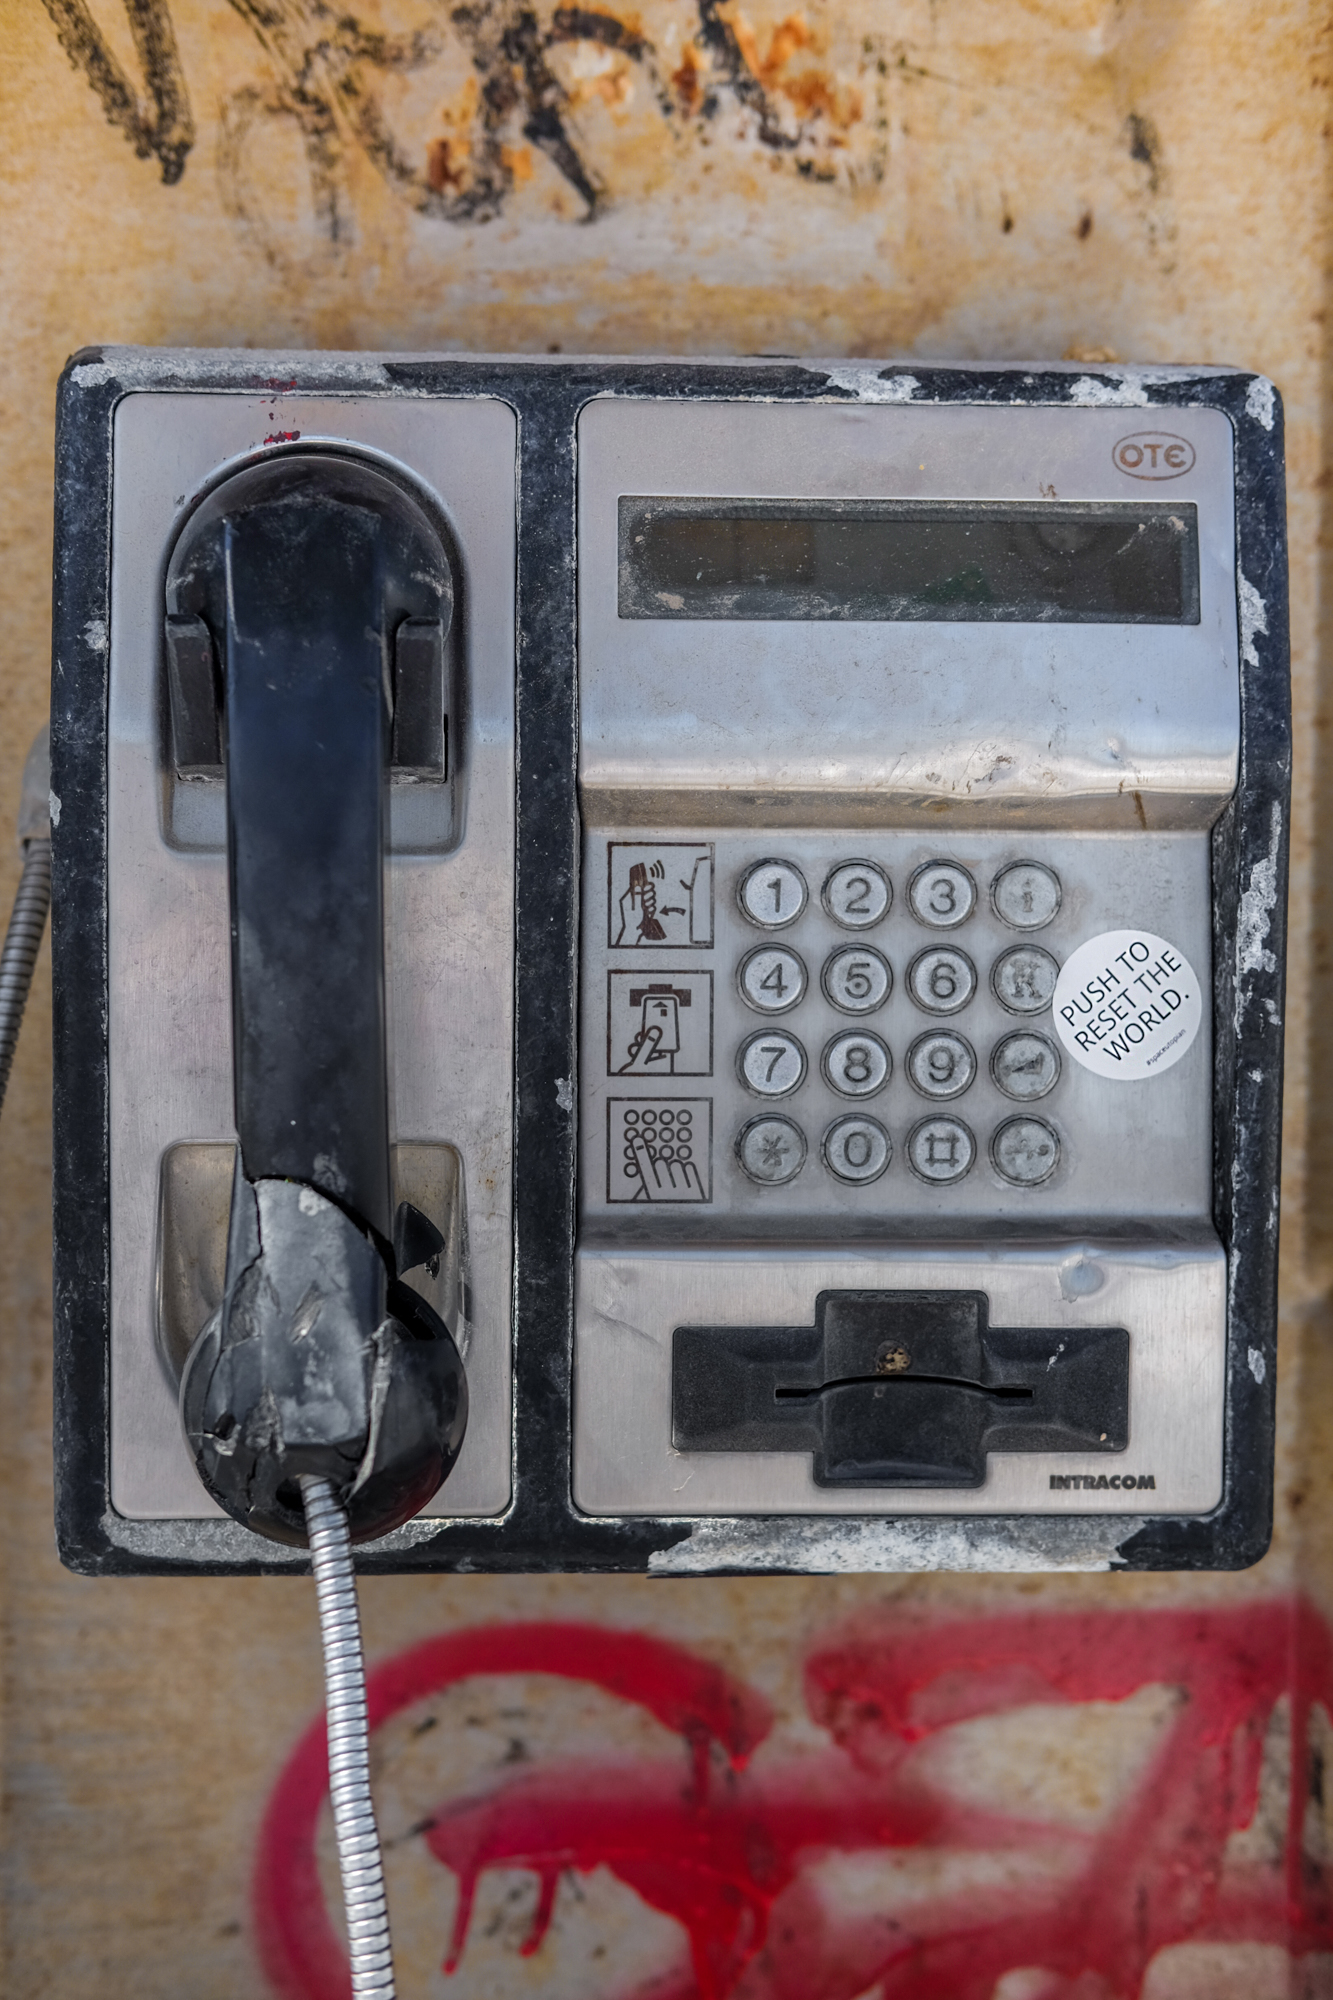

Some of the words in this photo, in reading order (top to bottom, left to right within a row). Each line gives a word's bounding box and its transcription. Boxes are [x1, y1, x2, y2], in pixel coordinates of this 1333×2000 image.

[1119, 443, 1187, 469] OTE
[766, 877, 781, 913] 1
[845, 877, 870, 914] 2
[929, 878, 956, 915] 3
[759, 962, 788, 998] 4
[844, 962, 872, 999] 5
[930, 962, 956, 999] 6
[1060, 967, 1121, 1027] PUSH
[1115, 941, 1150, 972] TO
[1074, 987, 1137, 1052] RESET
[1133, 950, 1182, 994] THE
[1102, 988, 1190, 1061] WORLD.
[760, 1046, 787, 1082] 7
[843, 1047, 872, 1082] 8
[928, 1046, 955, 1083] 9
[843, 1131, 872, 1167] 0
[1049, 1474, 1157, 1490] INTRACOM
